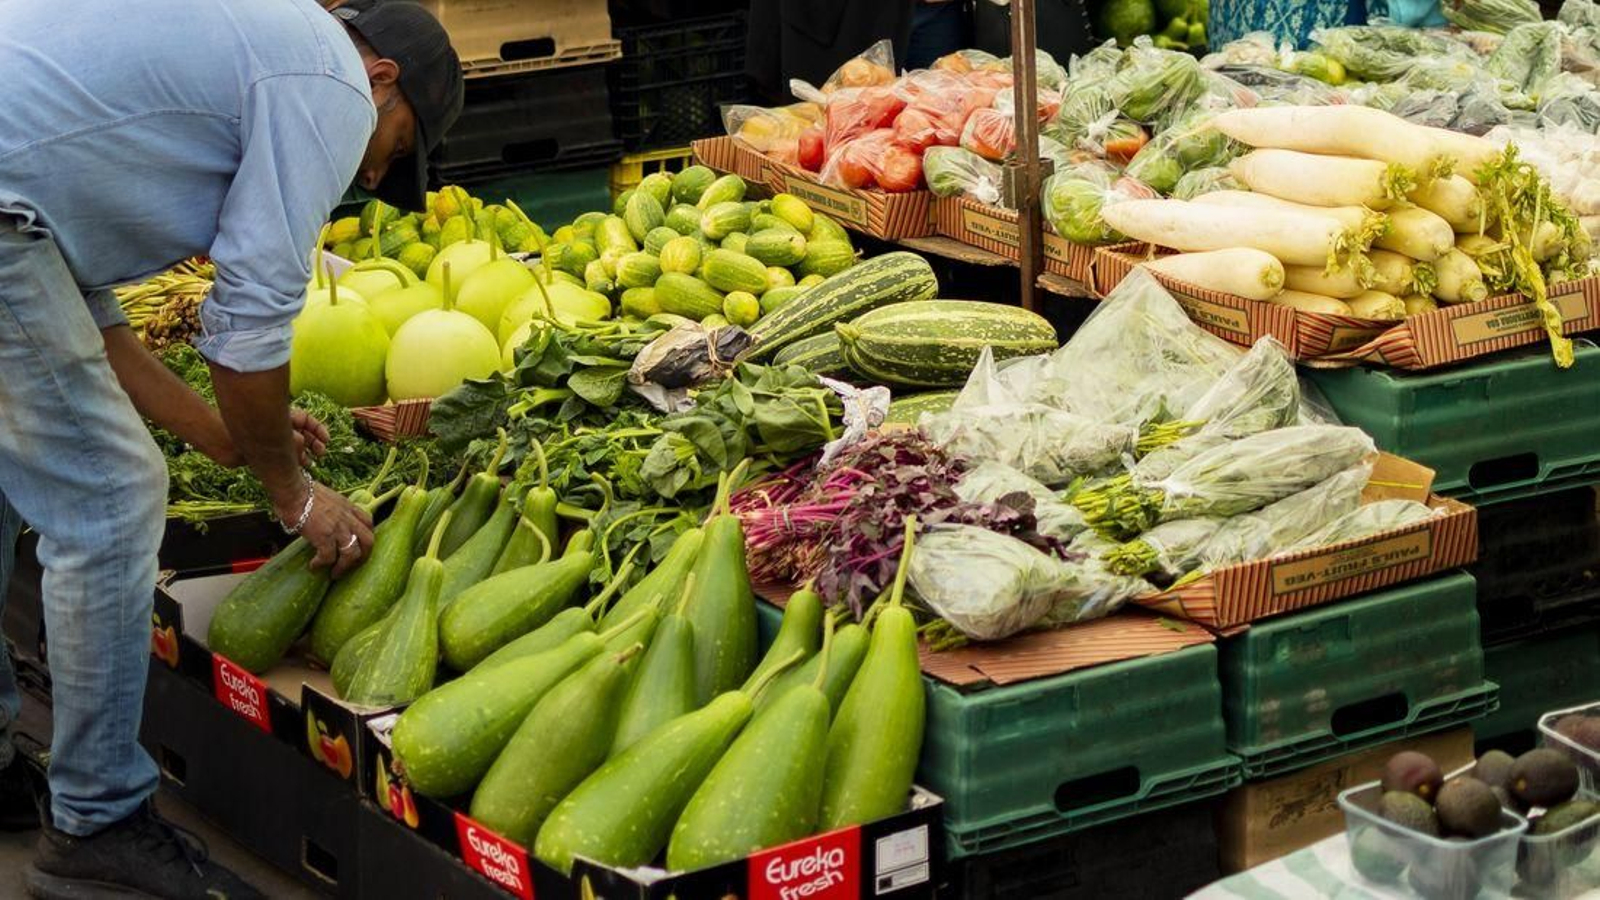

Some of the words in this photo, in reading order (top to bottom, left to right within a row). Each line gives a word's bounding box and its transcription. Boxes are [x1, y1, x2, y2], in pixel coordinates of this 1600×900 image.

[220, 663, 260, 706] Eureka
[229, 692, 262, 720] fresh
[467, 827, 519, 875] Eureka
[766, 846, 844, 884] Eureka
[481, 858, 523, 890] fresh
[779, 870, 844, 900] fresh
